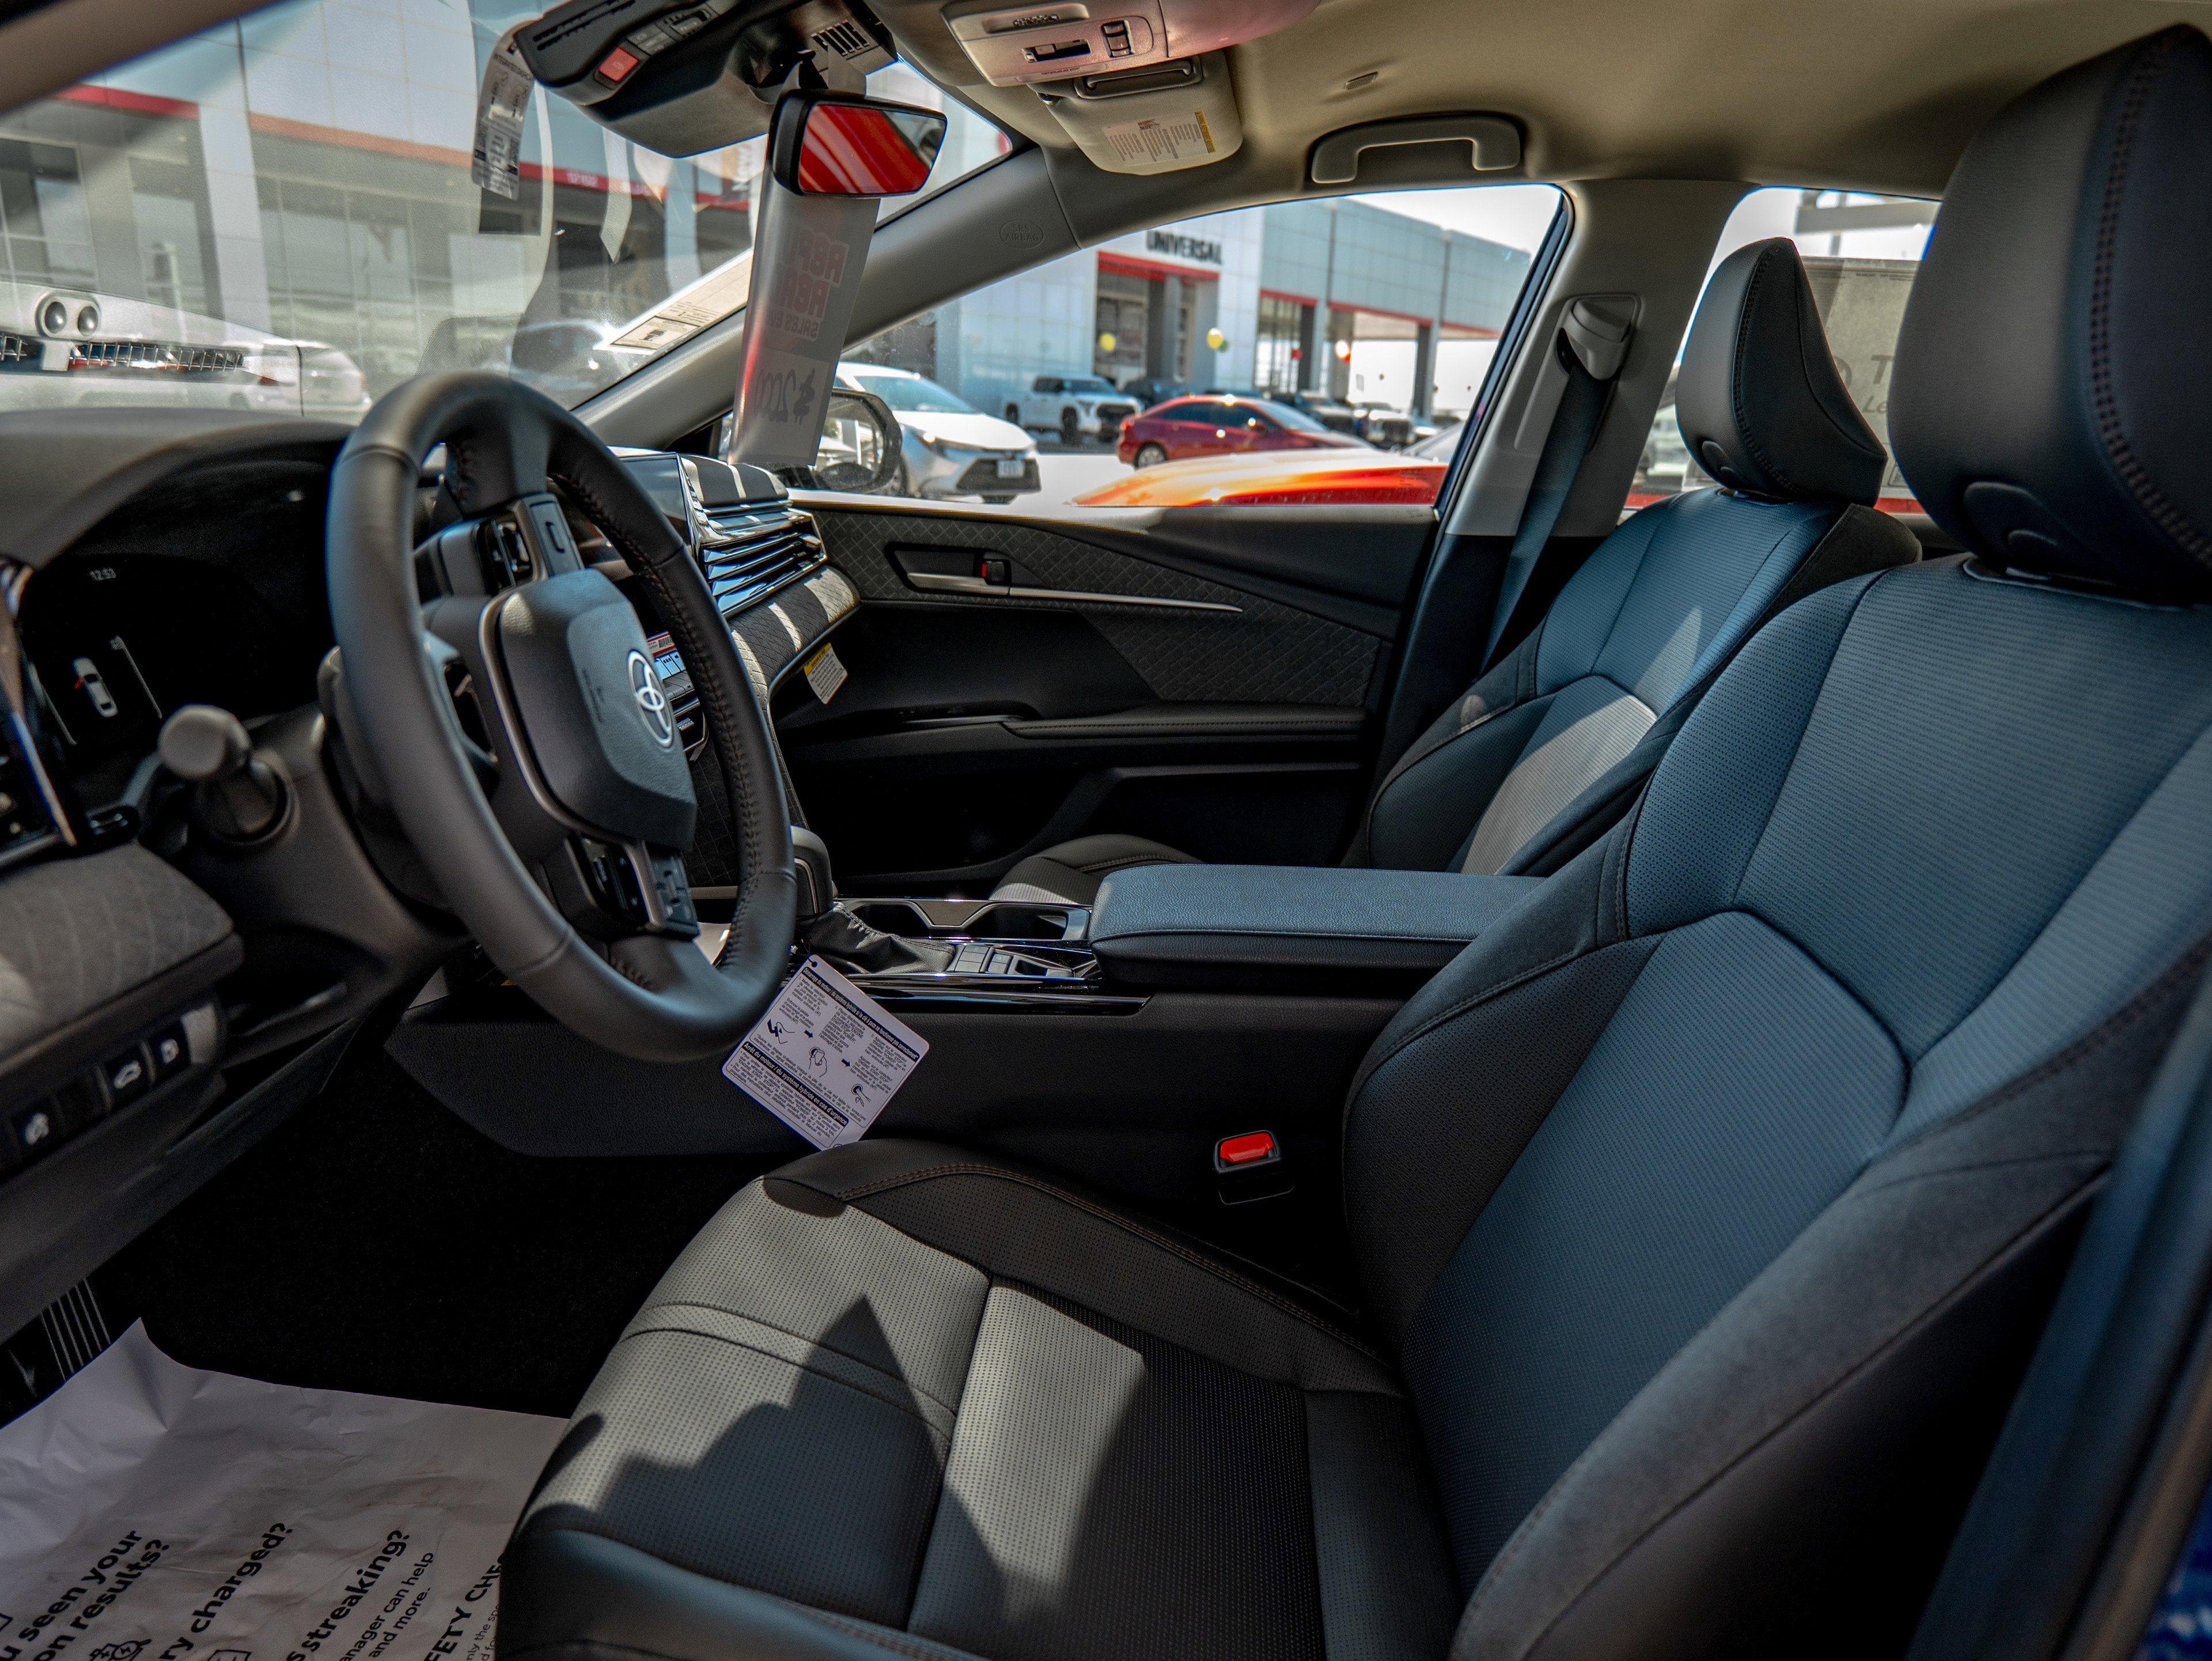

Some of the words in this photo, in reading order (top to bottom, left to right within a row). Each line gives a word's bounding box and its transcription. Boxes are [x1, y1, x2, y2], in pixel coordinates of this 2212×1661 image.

[1147, 230, 1222, 265] UNIVERSAL
[744, 1043, 756, 1054] Arrêt
[759, 1055, 775, 1069] moteur
[782, 1073, 800, 1088] système
[798, 1085, 815, 1100] hybride
[819, 1102, 828, 1110] cas
[827, 1107, 847, 1125] d'urgence
[18, 1587, 88, 1642] seen
[81, 1530, 142, 1584] your
[70, 1539, 170, 1630] results?
[191, 1523, 293, 1633] charged?
[301, 1530, 410, 1652] streaking?
[384, 1588, 410, 1613] can
[402, 1552, 434, 1585] help
[369, 1632, 398, 1658] and
[393, 1587, 431, 1629] more.
[475, 1624, 491, 1641] the
